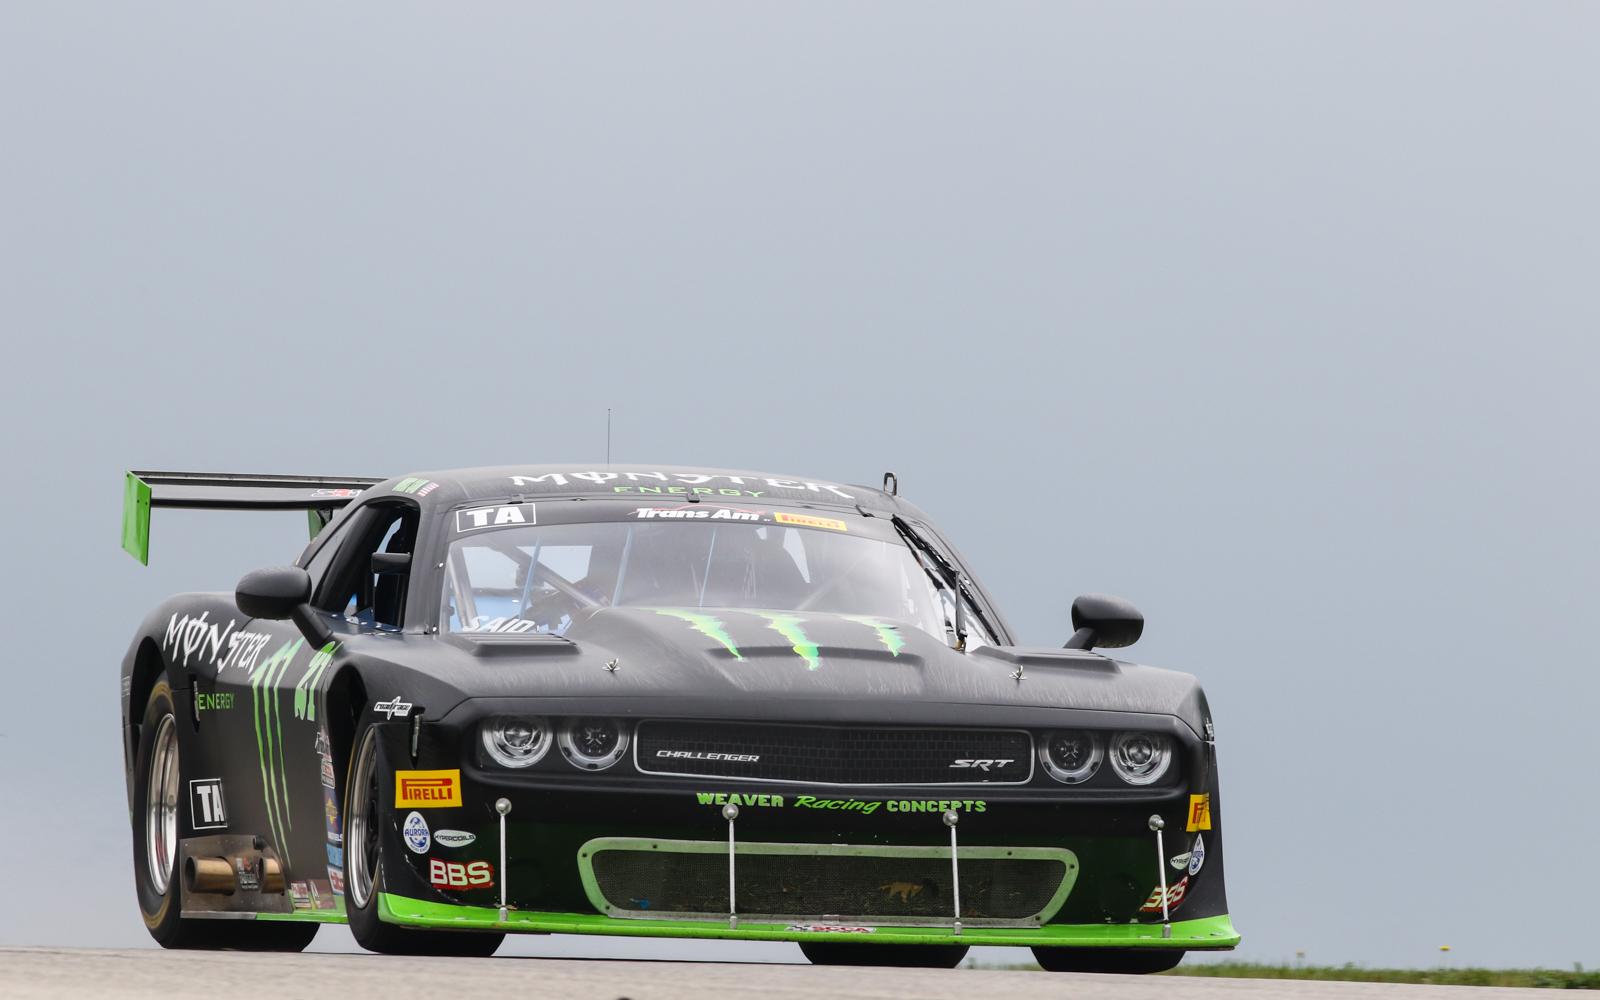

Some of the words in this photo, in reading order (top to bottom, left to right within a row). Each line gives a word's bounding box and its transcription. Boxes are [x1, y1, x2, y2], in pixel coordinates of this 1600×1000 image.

[613, 486, 765, 497] ENERGY
[466, 506, 526, 526] TA
[636, 508, 710, 518] Trans
[710, 509, 760, 520] Am
[462, 615, 535, 633] SAID
[198, 693, 235, 710] ENERGY
[656, 750, 760, 763] CHALLENGER
[949, 759, 1015, 771] SRT
[401, 778, 453, 800] PIRELLI
[196, 784, 225, 822] TA
[696, 792, 784, 808] WEAVER
[794, 795, 881, 815] Racing
[886, 800, 987, 812] CONCEPTS
[404, 828, 429, 837] AURORA
[430, 859, 491, 886] BBS
